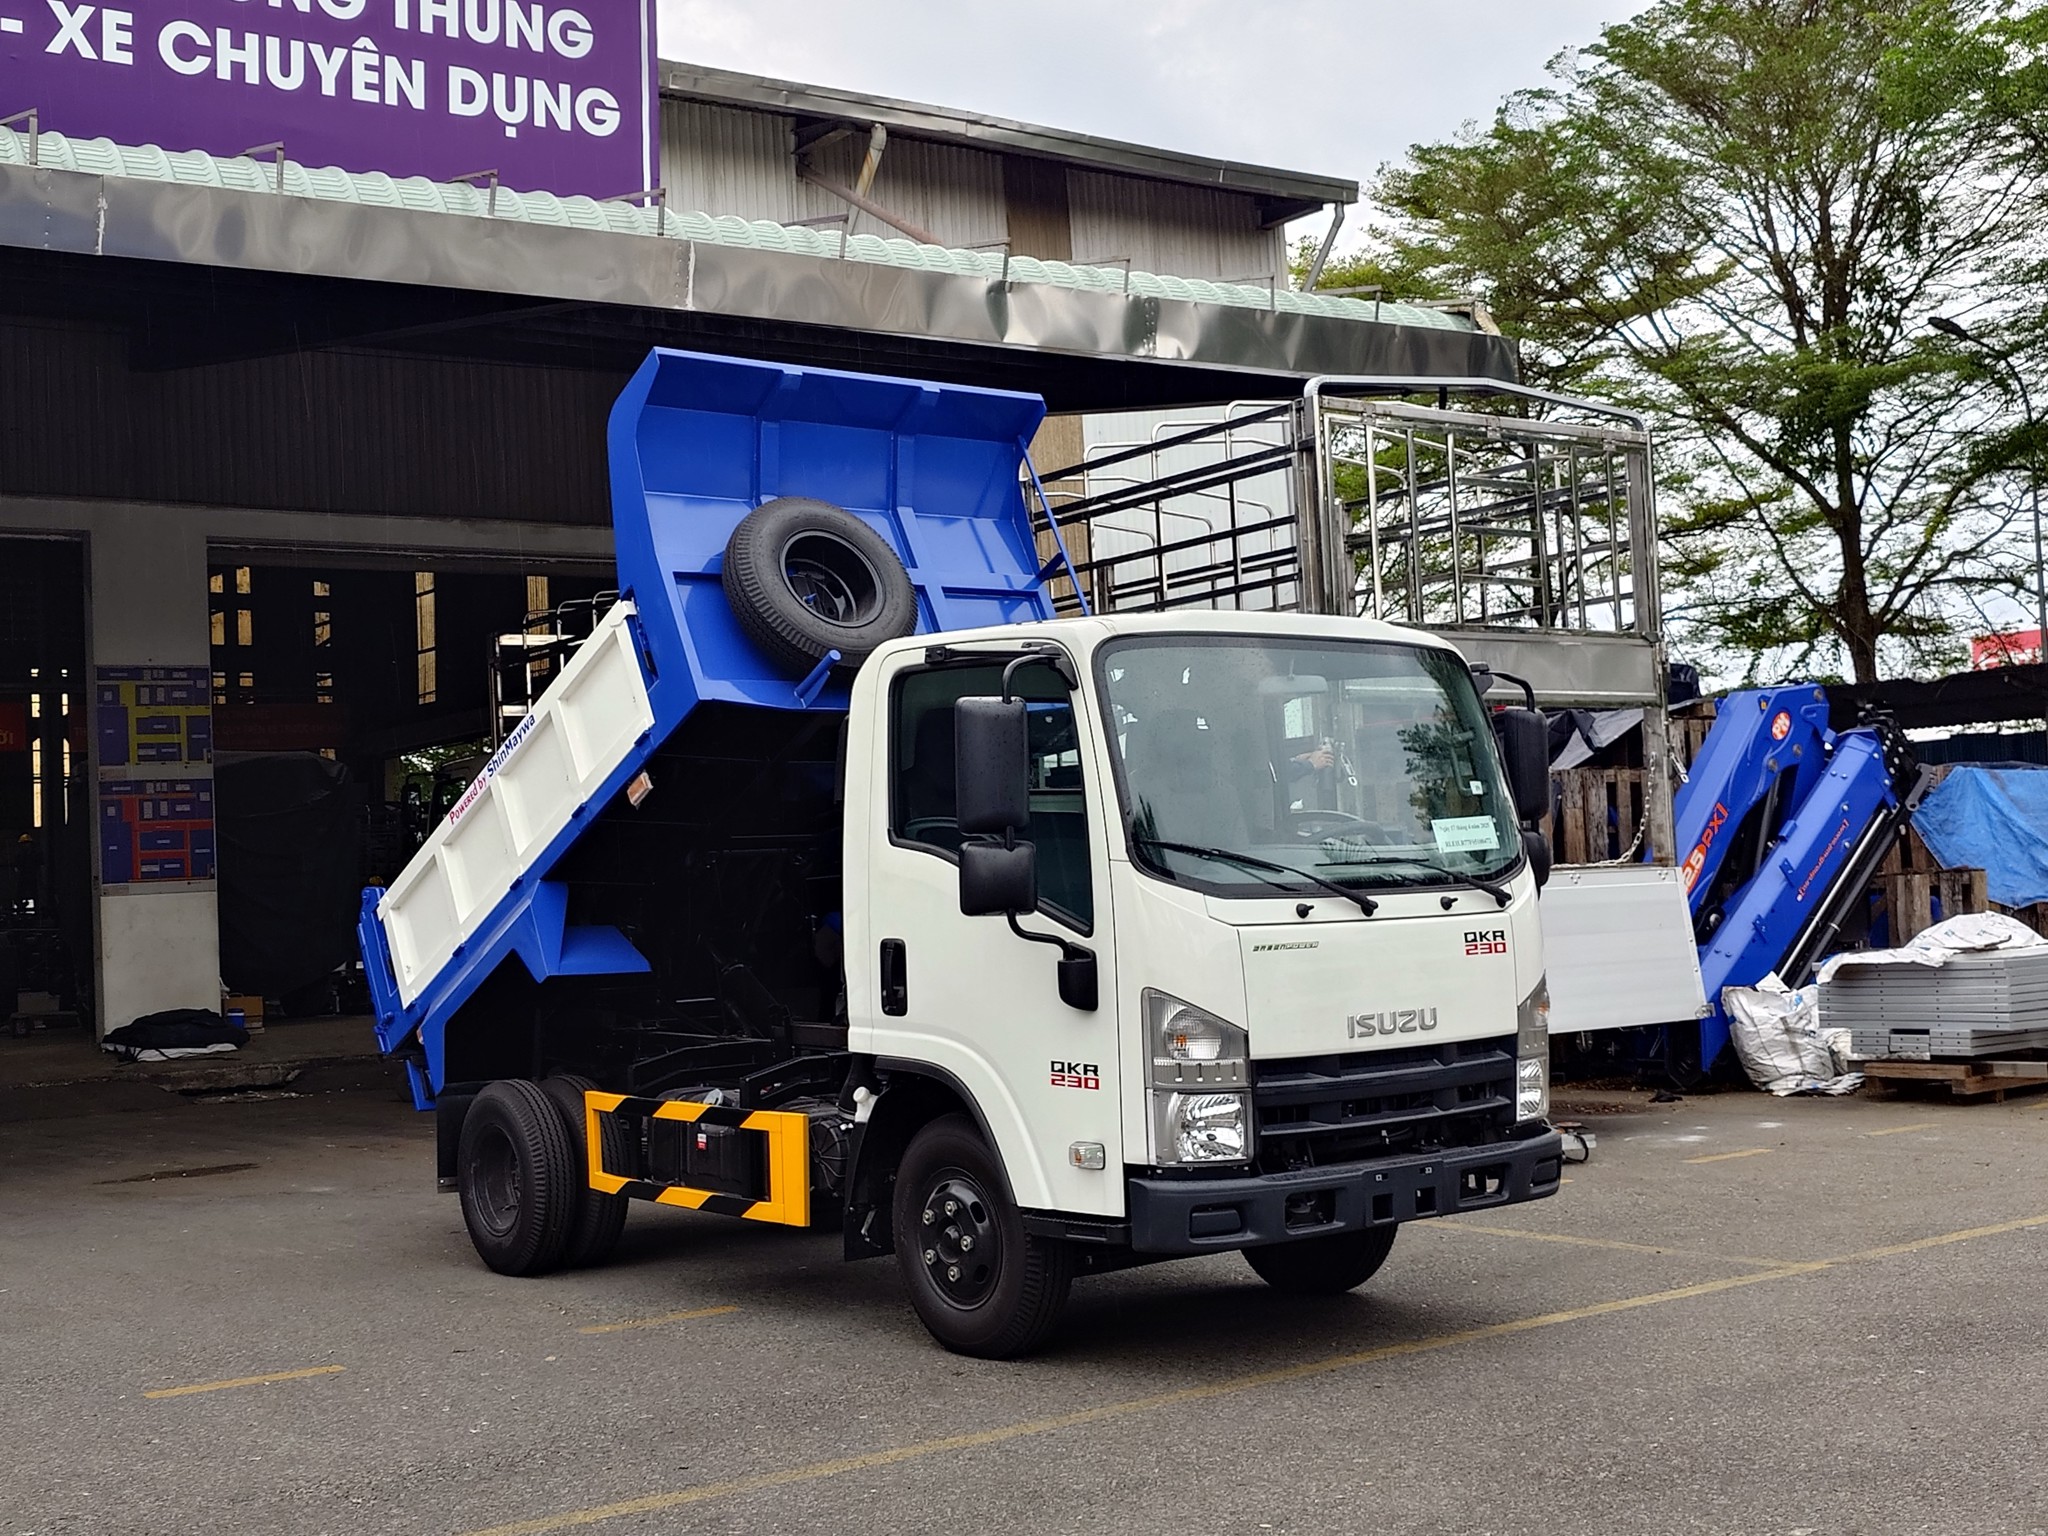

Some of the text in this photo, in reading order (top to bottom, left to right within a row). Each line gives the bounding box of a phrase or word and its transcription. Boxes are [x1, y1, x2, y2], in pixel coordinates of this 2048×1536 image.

[45, 0, 134, 65] XE
[157, 20, 425, 110] CHUYÊN
[448, 65, 621, 138] DỤNG
[486, 714, 536, 778] ShinMaywa
[1464, 930, 1506, 943] QKR
[1465, 942, 1507, 956] 230
[1347, 1007, 1437, 1039] ISUZU
[1050, 1060, 1099, 1077] QKR
[1050, 1073, 1100, 1091] 230
